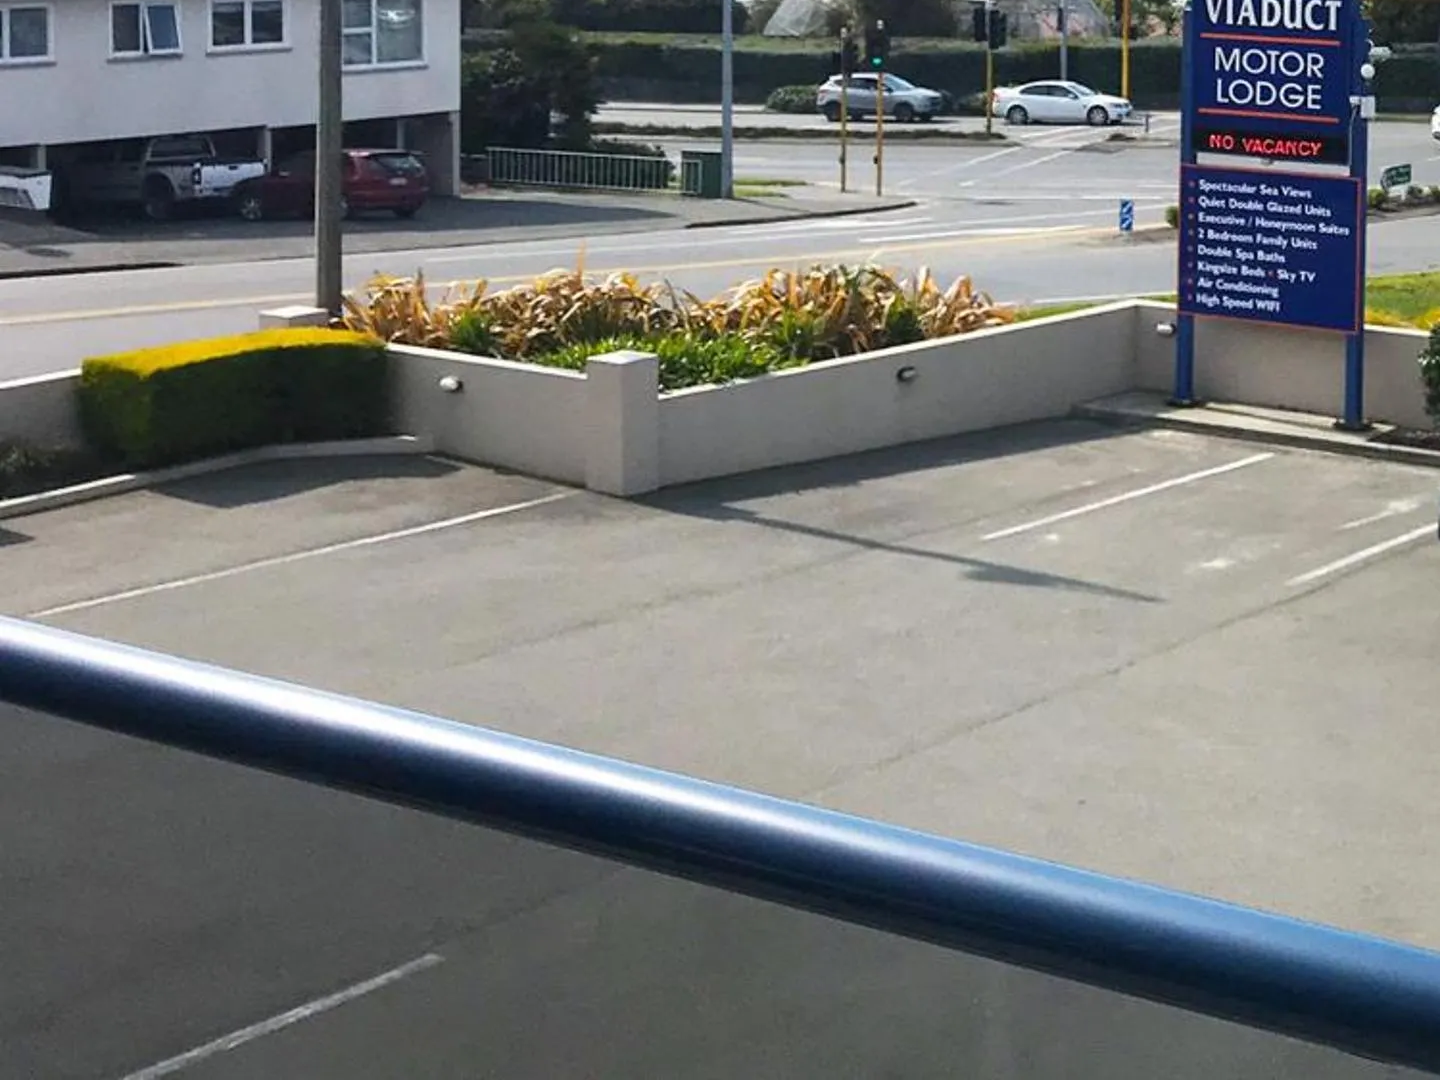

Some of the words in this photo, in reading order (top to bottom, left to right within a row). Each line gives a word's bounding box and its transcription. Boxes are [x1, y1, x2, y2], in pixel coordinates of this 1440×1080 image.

[1214, 46, 1324, 78] MOTOR
[1216, 78, 1323, 109] LODGE
[1209, 134, 1235, 150] NO
[1242, 138, 1322, 156] VACANCY
[1199, 179, 1257, 194] Spectacular
[1259, 184, 1279, 196] Sea
[1281, 185, 1313, 199] Views
[1198, 196, 1226, 209] Quiet
[1228, 198, 1264, 211] Double
[1266, 201, 1303, 215] Glazed
[1304, 204, 1332, 217] Units
[1198, 212, 1246, 226] Executive
[1255, 216, 1316, 232] Honeymoon
[1318, 222, 1350, 236] Suites
[1198, 227, 1205, 239] 2
[1207, 228, 1254, 243] Bedroom
[1256, 233, 1288, 249] Family
[1291, 236, 1318, 249] Units
[1197, 244, 1233, 257] Double
[1235, 248, 1255, 261] Spa
[1256, 250, 1286, 263] Baths
[1197, 261, 1238, 276] Kingsize
[1241, 265, 1266, 278] Beds
[1276, 269, 1296, 283] Sky
[1299, 270, 1316, 282] TV
[1197, 277, 1213, 288] Air
[1215, 279, 1279, 298] Conditioning
[1196, 293, 1220, 307] High
[1222, 296, 1254, 309] Speed
